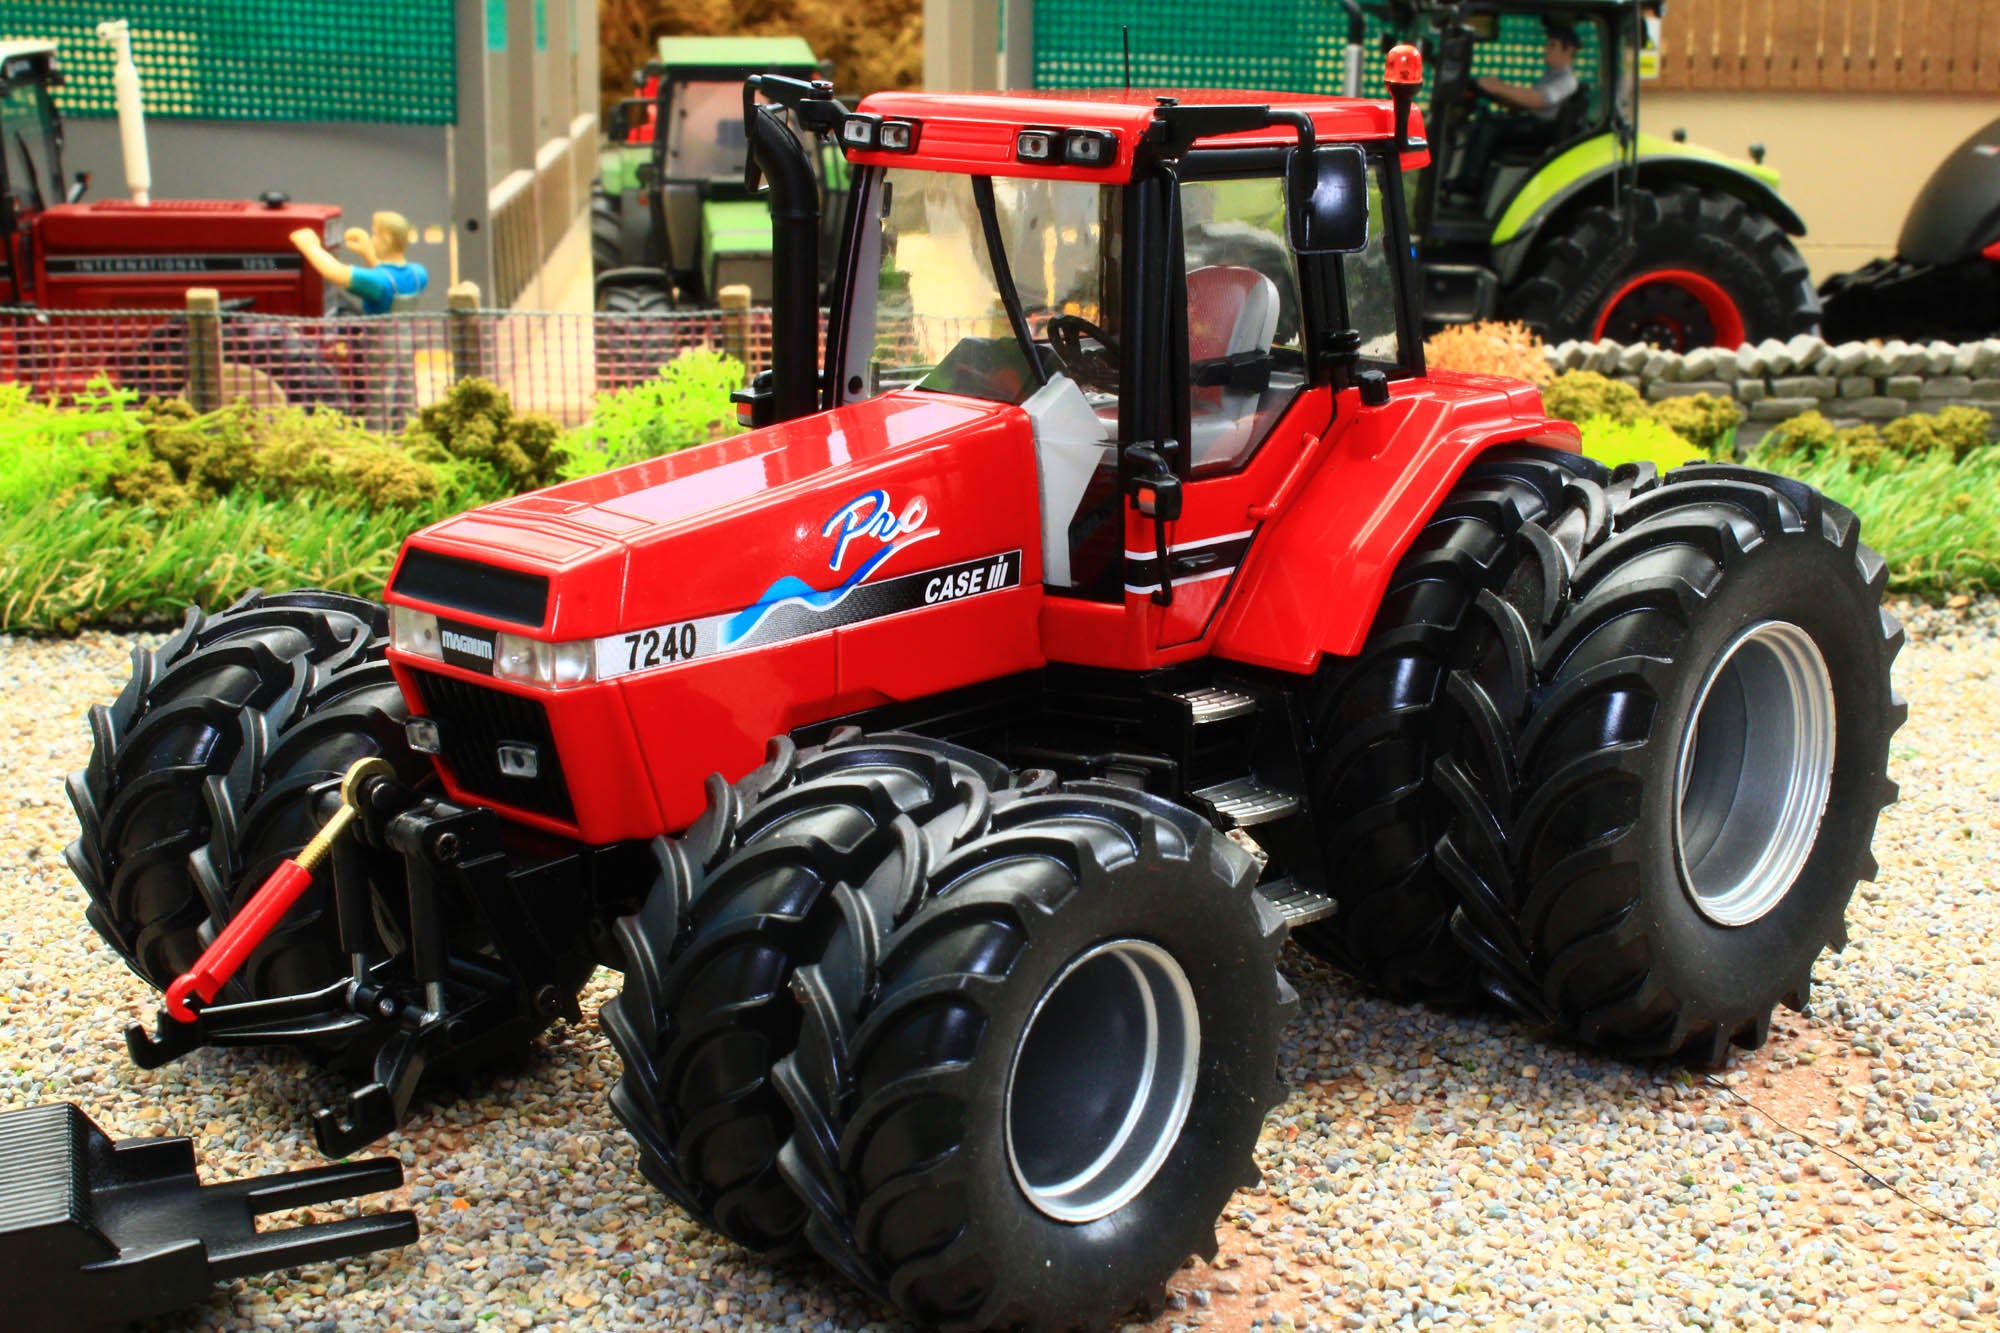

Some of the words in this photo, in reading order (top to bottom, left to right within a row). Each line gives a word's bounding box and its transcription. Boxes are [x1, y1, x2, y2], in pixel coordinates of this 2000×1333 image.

[822, 489, 932, 571] Pro
[925, 571, 984, 604] CASE
[442, 630, 493, 660] MAGNUM
[625, 622, 697, 670] 7240
